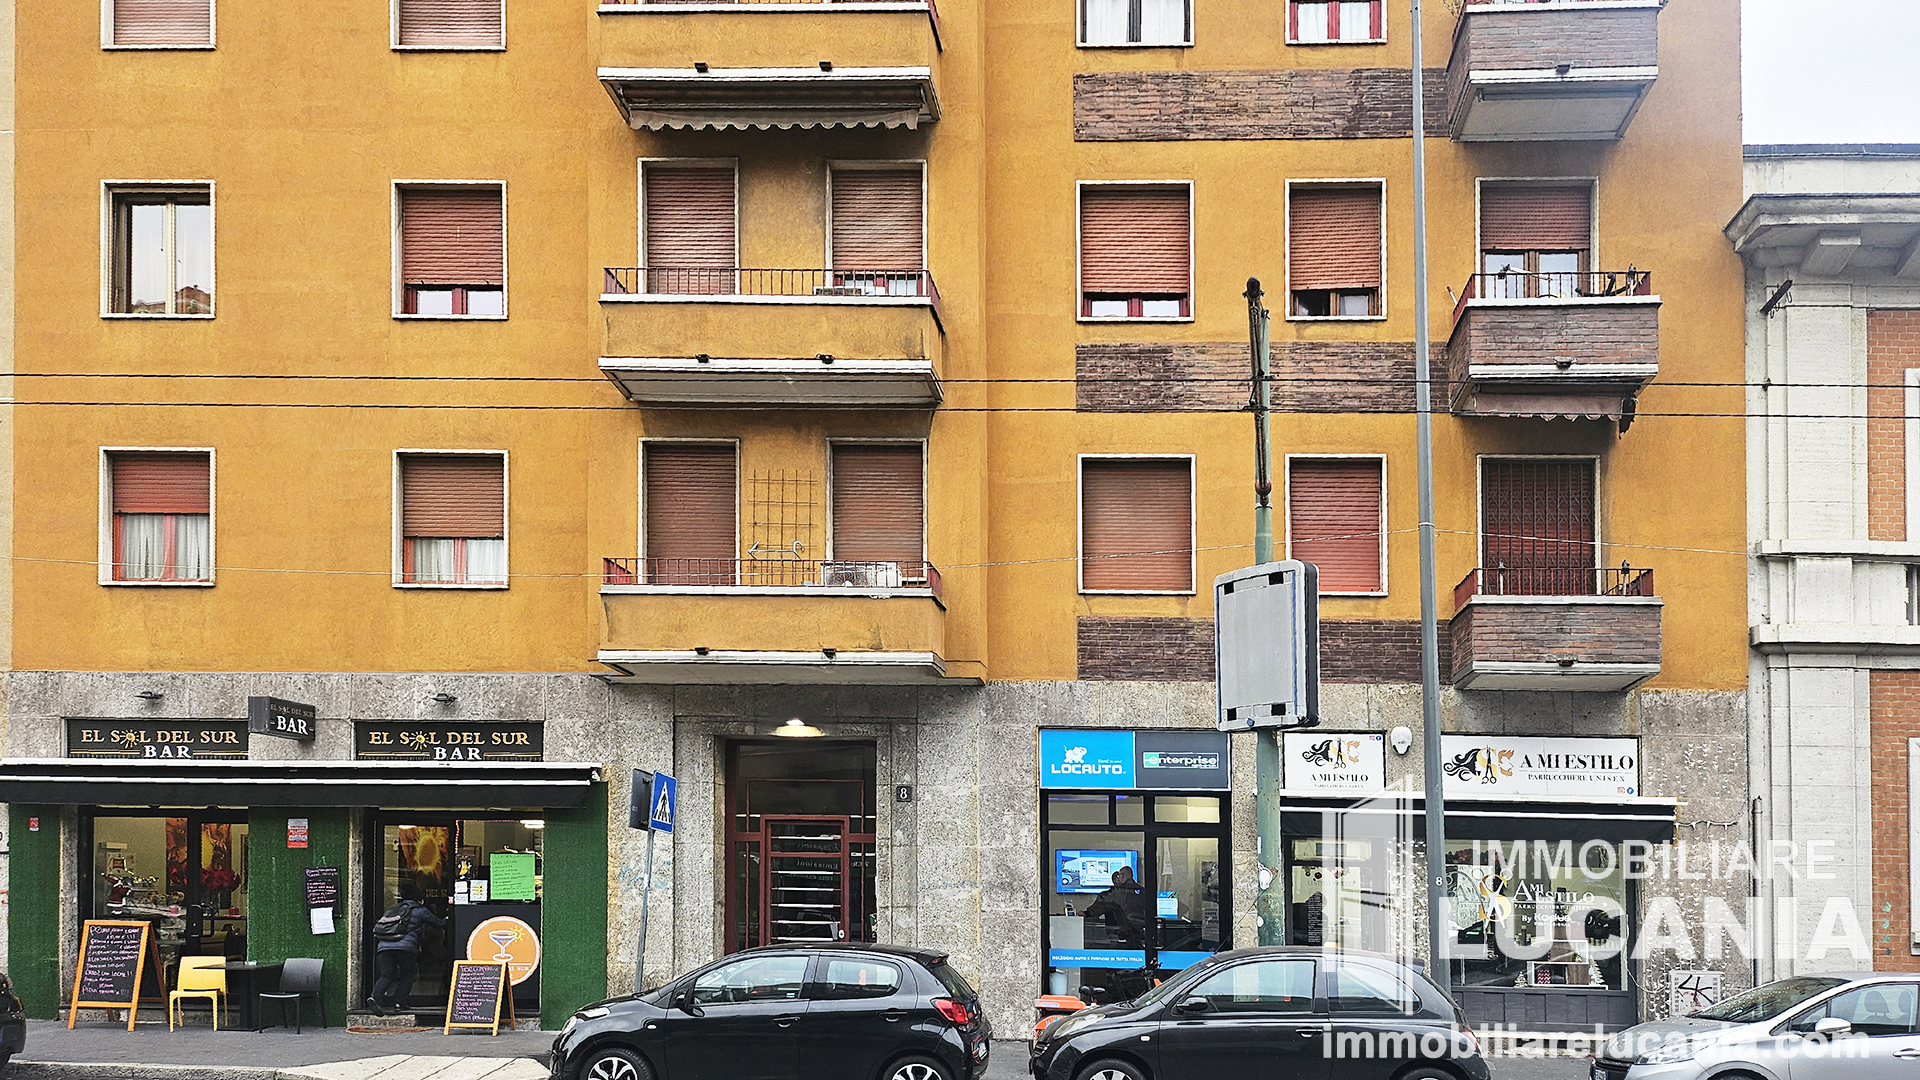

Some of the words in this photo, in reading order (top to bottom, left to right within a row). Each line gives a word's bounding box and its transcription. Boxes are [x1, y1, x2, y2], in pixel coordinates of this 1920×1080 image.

[276, 715, 308, 735] BAR
[81, 729, 104, 743] EL
[156, 730, 194, 744] DEL
[200, 730, 239, 744] SUR
[369, 731, 394, 745] EL
[446, 732, 485, 745] DEL
[491, 732, 530, 745] SUR
[143, 745, 191, 758] BAR
[433, 747, 482, 760] BAR
[1148, 755, 1217, 766] enterprise
[1520, 753, 1533, 768] A
[1536, 753, 1560, 769] MI
[1565, 754, 1634, 770] ESTILO
[1051, 764, 1123, 775] LOCAUTO
[1310, 773, 1317, 782] A
[1528, 774, 1589, 782] PARRUCCHIERE
[900, 787, 908, 799] 8
[1435, 876, 1443, 886] 8
